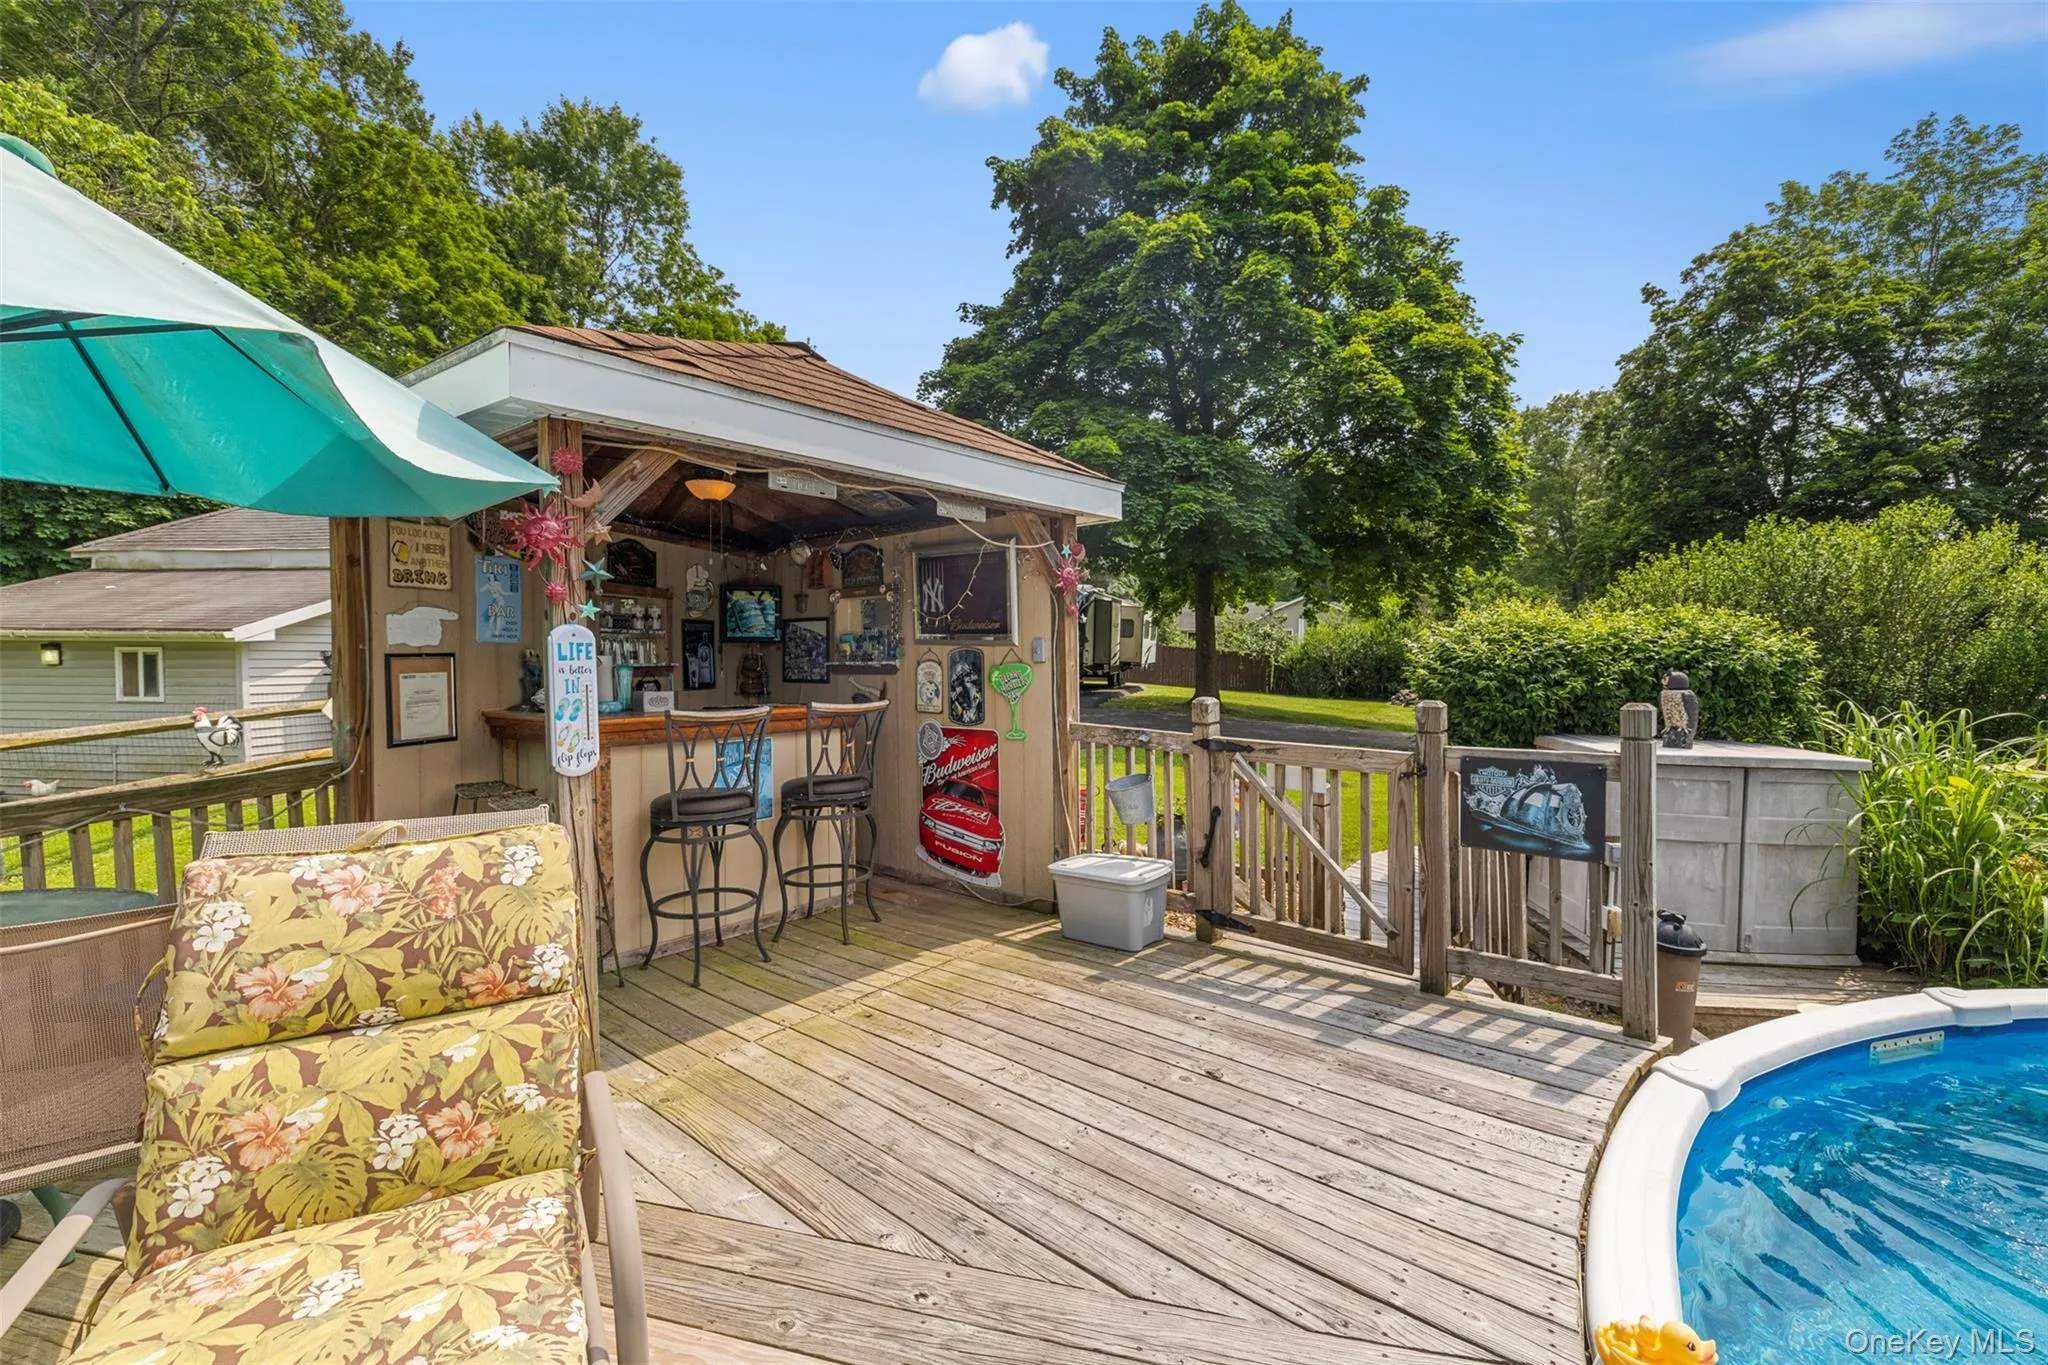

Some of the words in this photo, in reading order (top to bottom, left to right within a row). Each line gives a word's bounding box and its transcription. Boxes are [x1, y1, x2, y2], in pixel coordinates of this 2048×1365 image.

[392, 568, 448, 585] DRINK
[488, 604, 515, 618] BAR
[558, 642, 593, 661] LIFE
[569, 664, 592, 675] better
[565, 679, 580, 694] IN
[557, 752, 574, 768] flip
[577, 749, 597, 768] flops
[923, 744, 998, 787] Budweiser
[934, 801, 988, 820] Bud
[935, 840, 983, 863] FUSION
